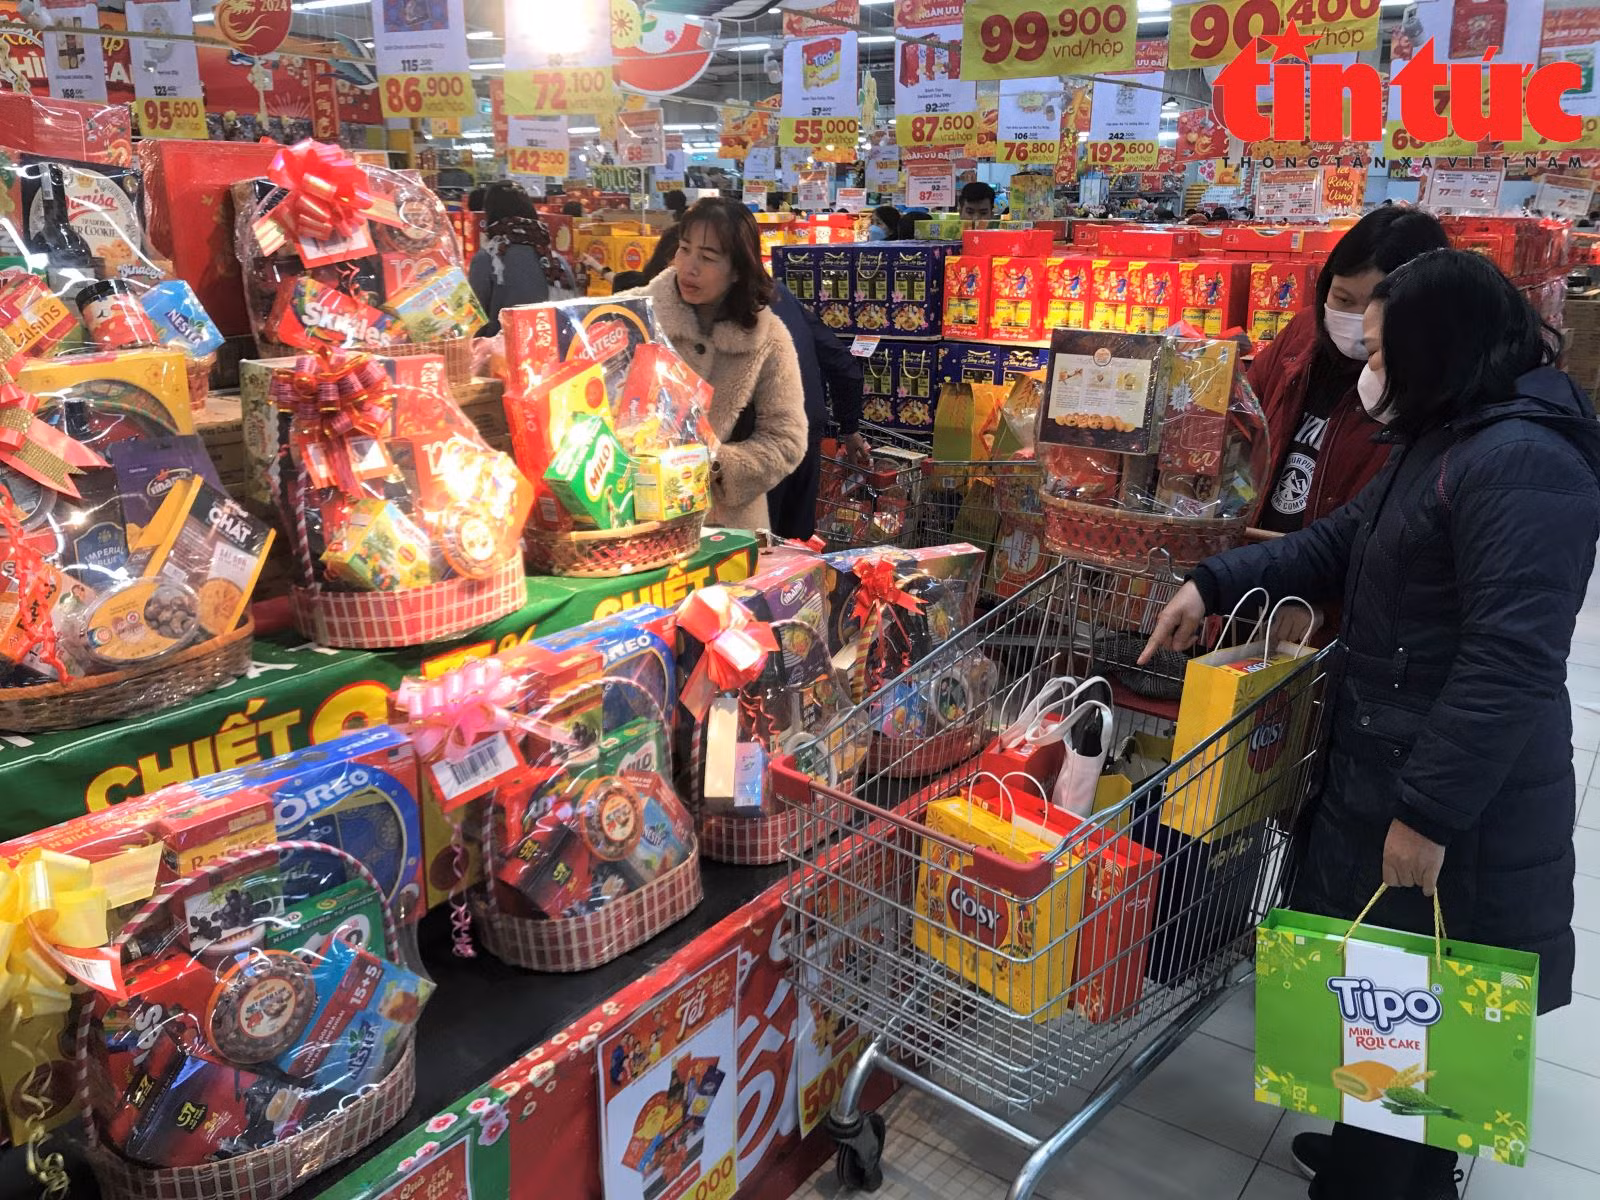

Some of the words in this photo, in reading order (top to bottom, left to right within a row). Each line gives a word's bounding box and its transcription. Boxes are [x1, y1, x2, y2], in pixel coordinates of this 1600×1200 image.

[981, 5, 1126, 64] 99.900
[1053, 38, 1124, 60] vnd/hộp
[386, 77, 464, 112] 86.900
[534, 72, 605, 110] 72.100
[145, 101, 198, 130] 95.600
[793, 120, 857, 145] 55.000
[911, 115, 974, 142] 87.600
[1004, 142, 1055, 162] 76.800
[1090, 142, 1155, 163] 192.600
[302, 302, 393, 348] Skittles
[588, 443, 611, 489] MILO
[593, 563, 710, 621] CHIẾT
[86, 698, 301, 813] CHIẾT
[274, 768, 369, 826] OREO
[950, 887, 1001, 930] COSY
[675, 989, 708, 1040] Tết
[1356, 1036, 1387, 1051] ROLL
[1388, 1038, 1421, 1051] CAKE
